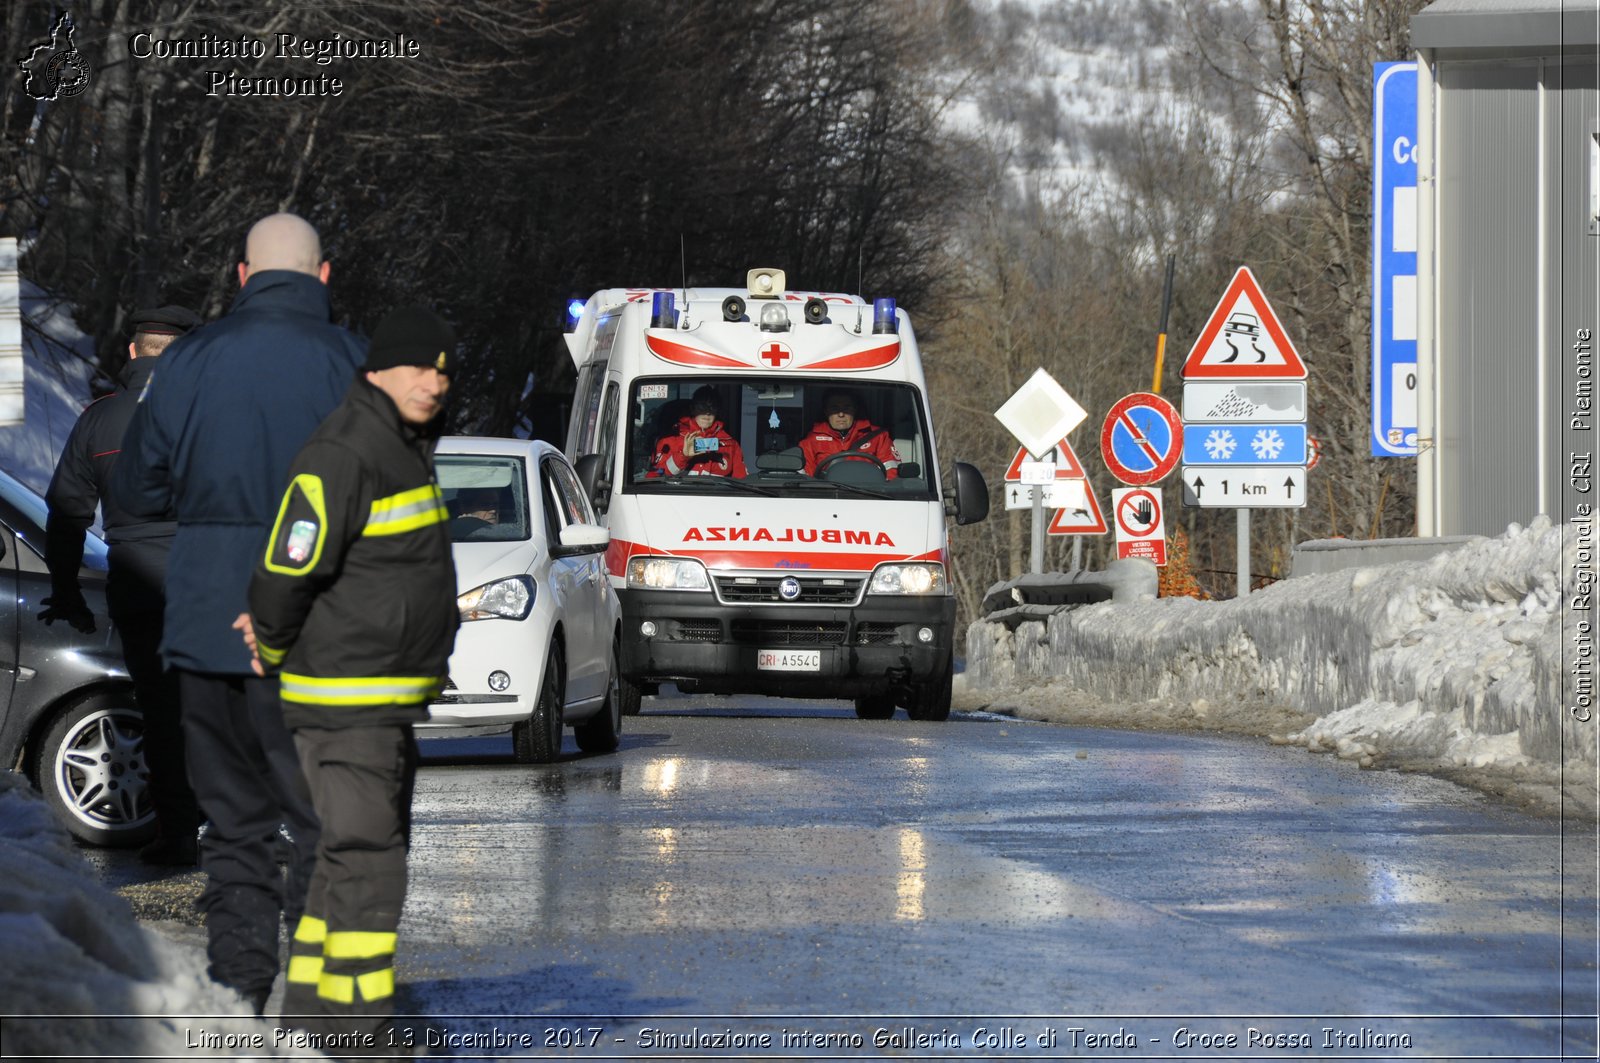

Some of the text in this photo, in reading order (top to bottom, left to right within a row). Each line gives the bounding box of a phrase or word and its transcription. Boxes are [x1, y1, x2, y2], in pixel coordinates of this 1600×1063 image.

[1221, 480, 1267, 495] 1 km
[759, 655, 776, 666] CRI
